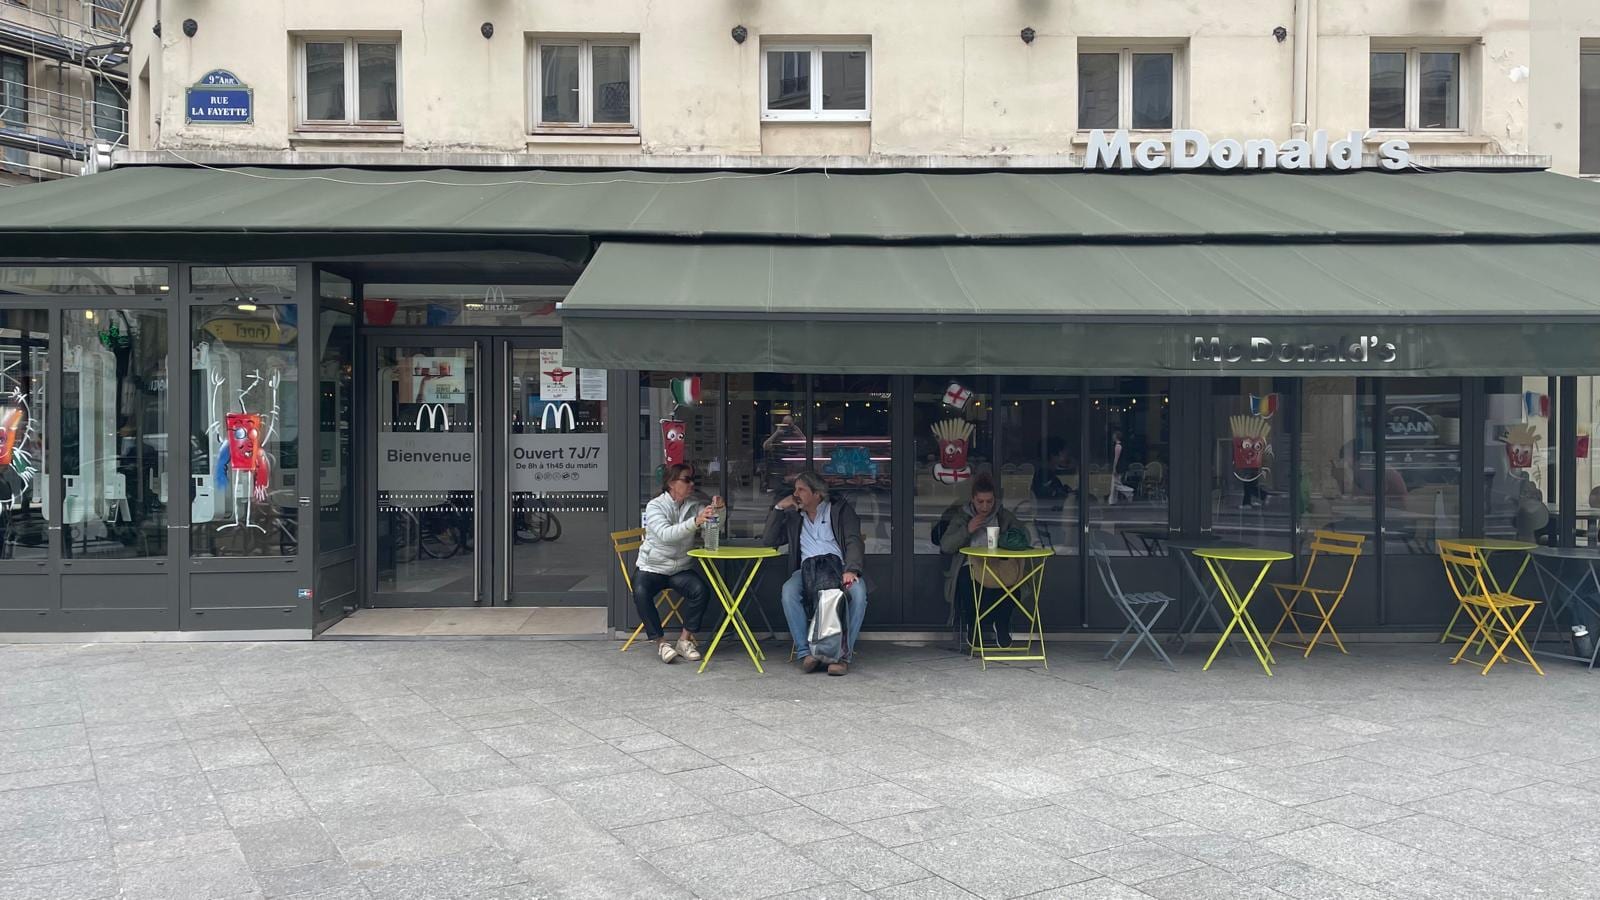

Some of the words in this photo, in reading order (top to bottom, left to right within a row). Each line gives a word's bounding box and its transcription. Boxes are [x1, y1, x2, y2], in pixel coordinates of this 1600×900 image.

[210, 96, 229, 105] RUE
[191, 107, 205, 116] LA
[207, 107, 248, 116] FAYETTE
[387, 449, 472, 462] Bienvenue
[513, 447, 564, 460] Ouvert
[568, 446, 601, 460] 7J/7
[515, 462, 527, 470] De
[528, 462, 538, 470] 8h
[538, 461, 544, 470] à
[546, 462, 564, 470] 1h45
[565, 462, 575, 470] du
[576, 462, 599, 470] matin
